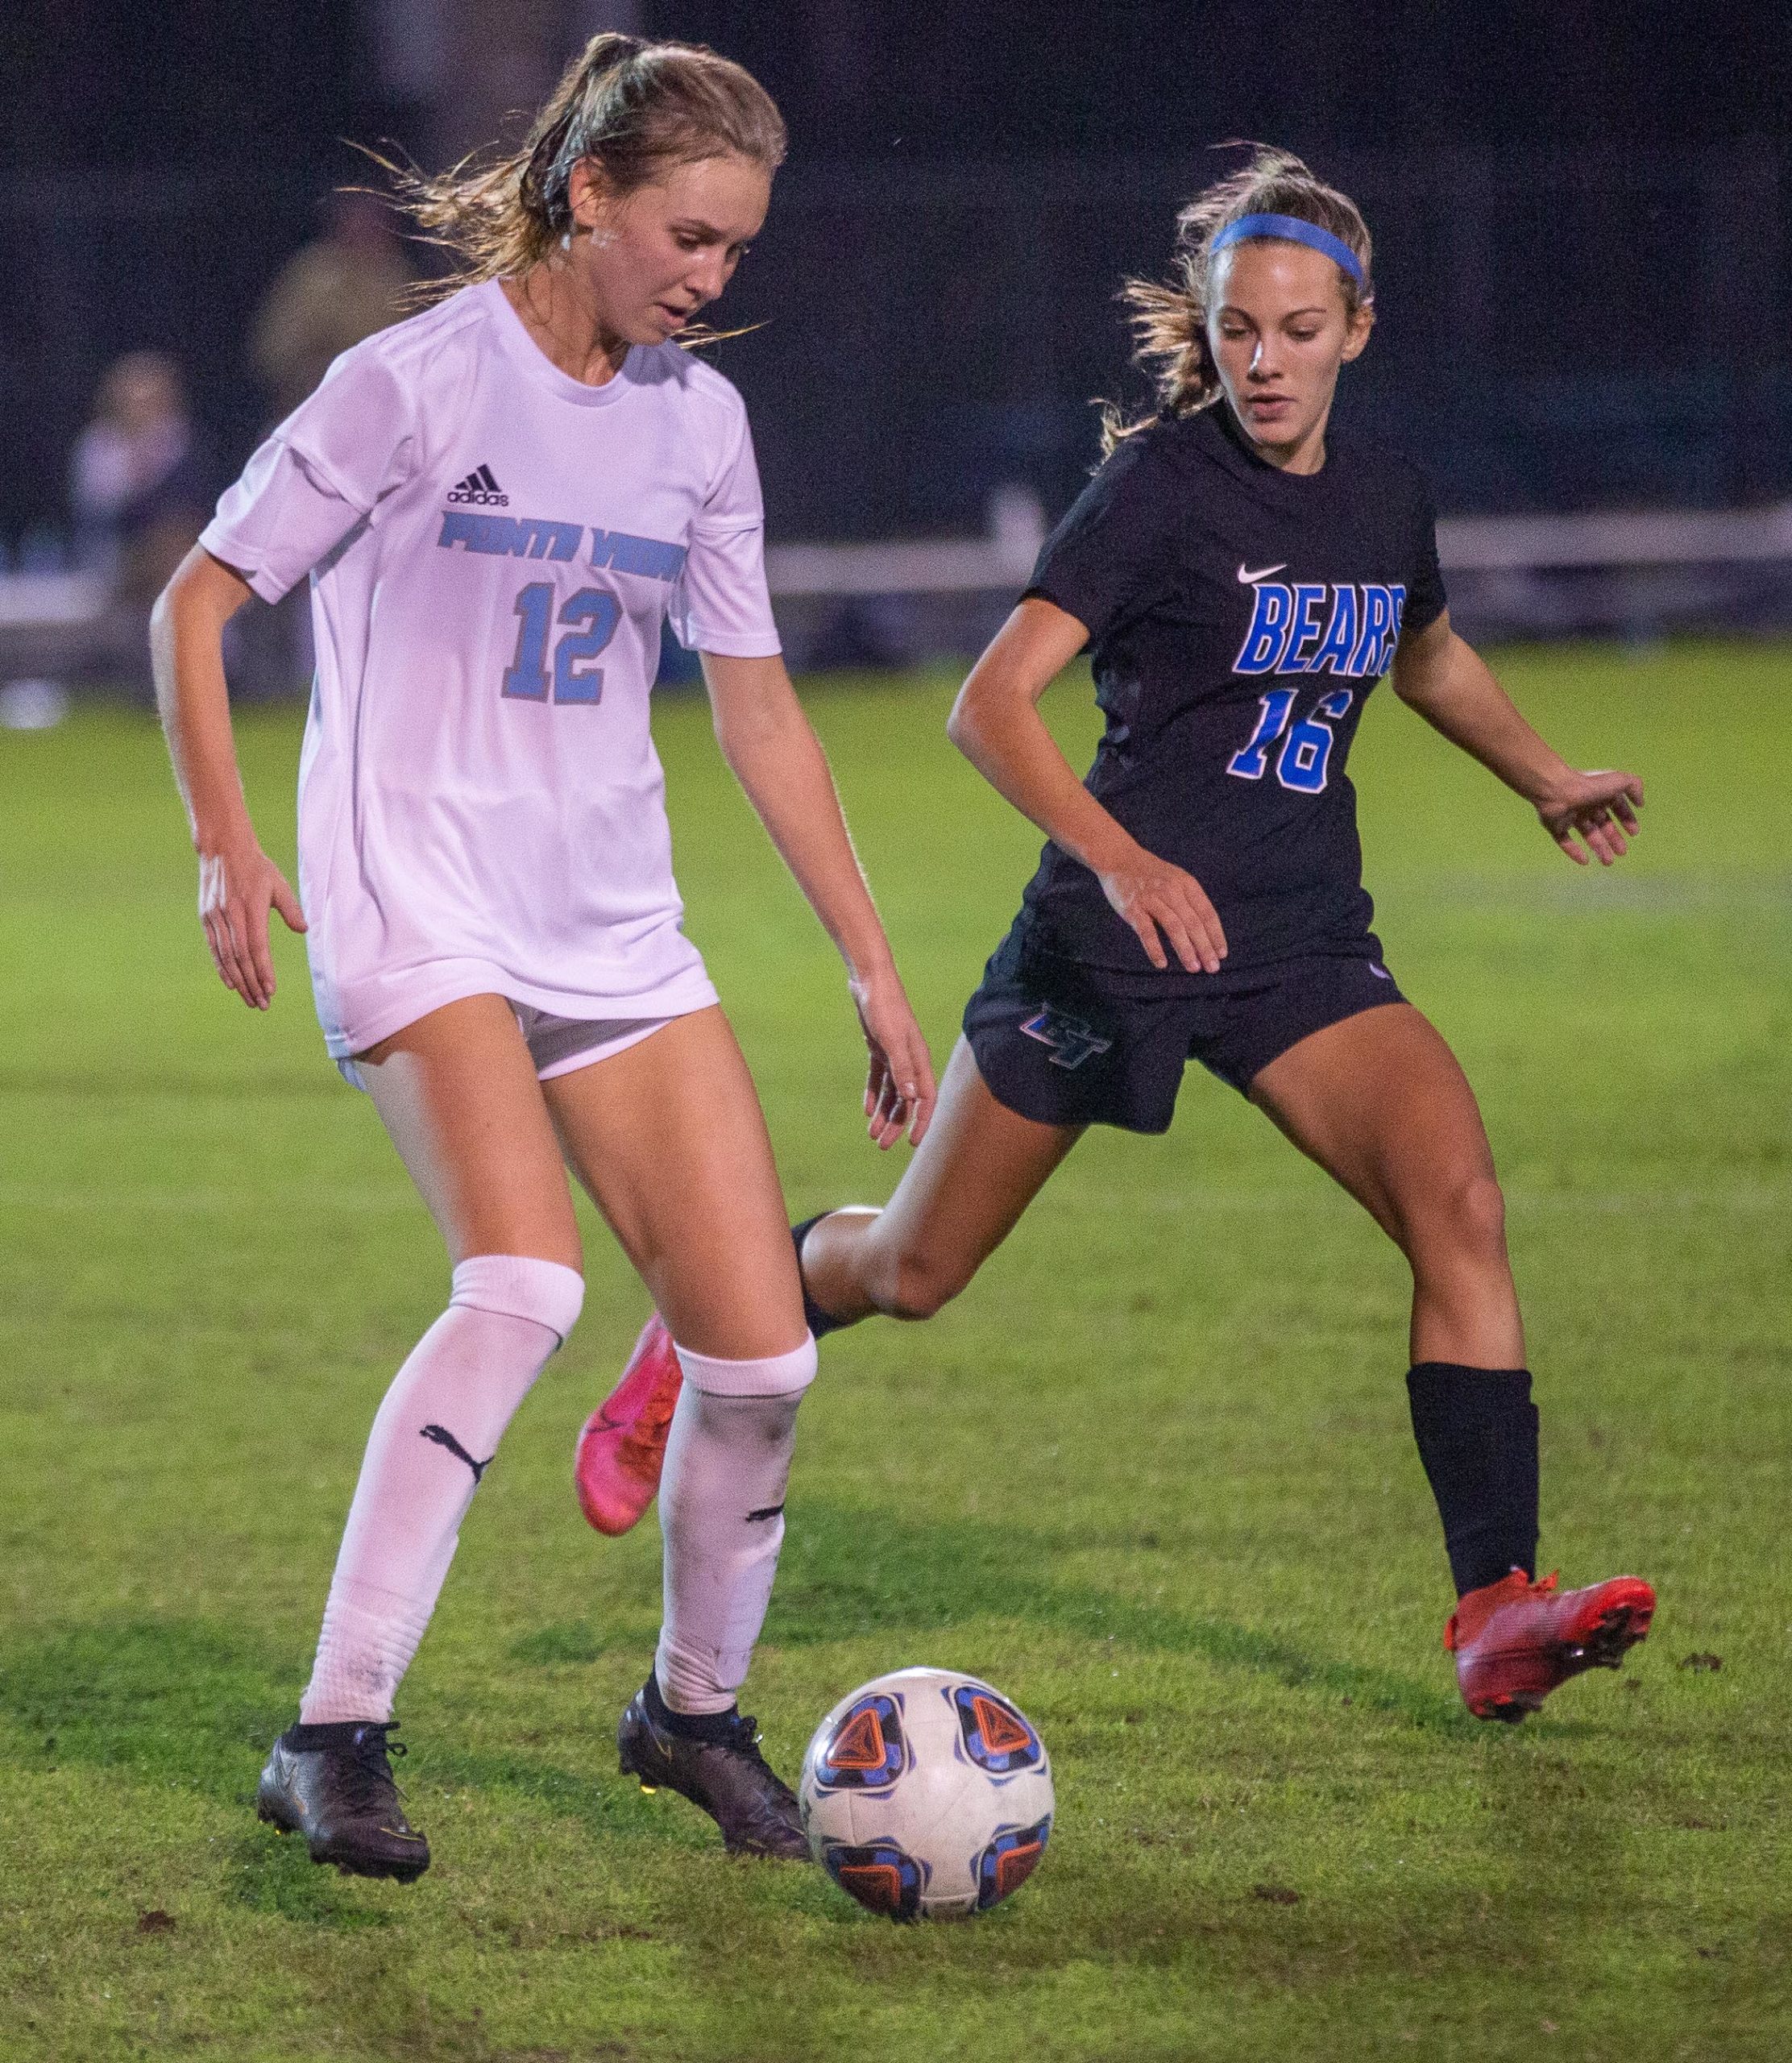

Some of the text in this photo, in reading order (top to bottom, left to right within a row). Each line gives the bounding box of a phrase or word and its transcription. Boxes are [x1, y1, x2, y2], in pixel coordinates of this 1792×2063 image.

[446, 491, 509, 507] adidas
[500, 582, 624, 706] 12
[1226, 688, 1354, 795] 16
